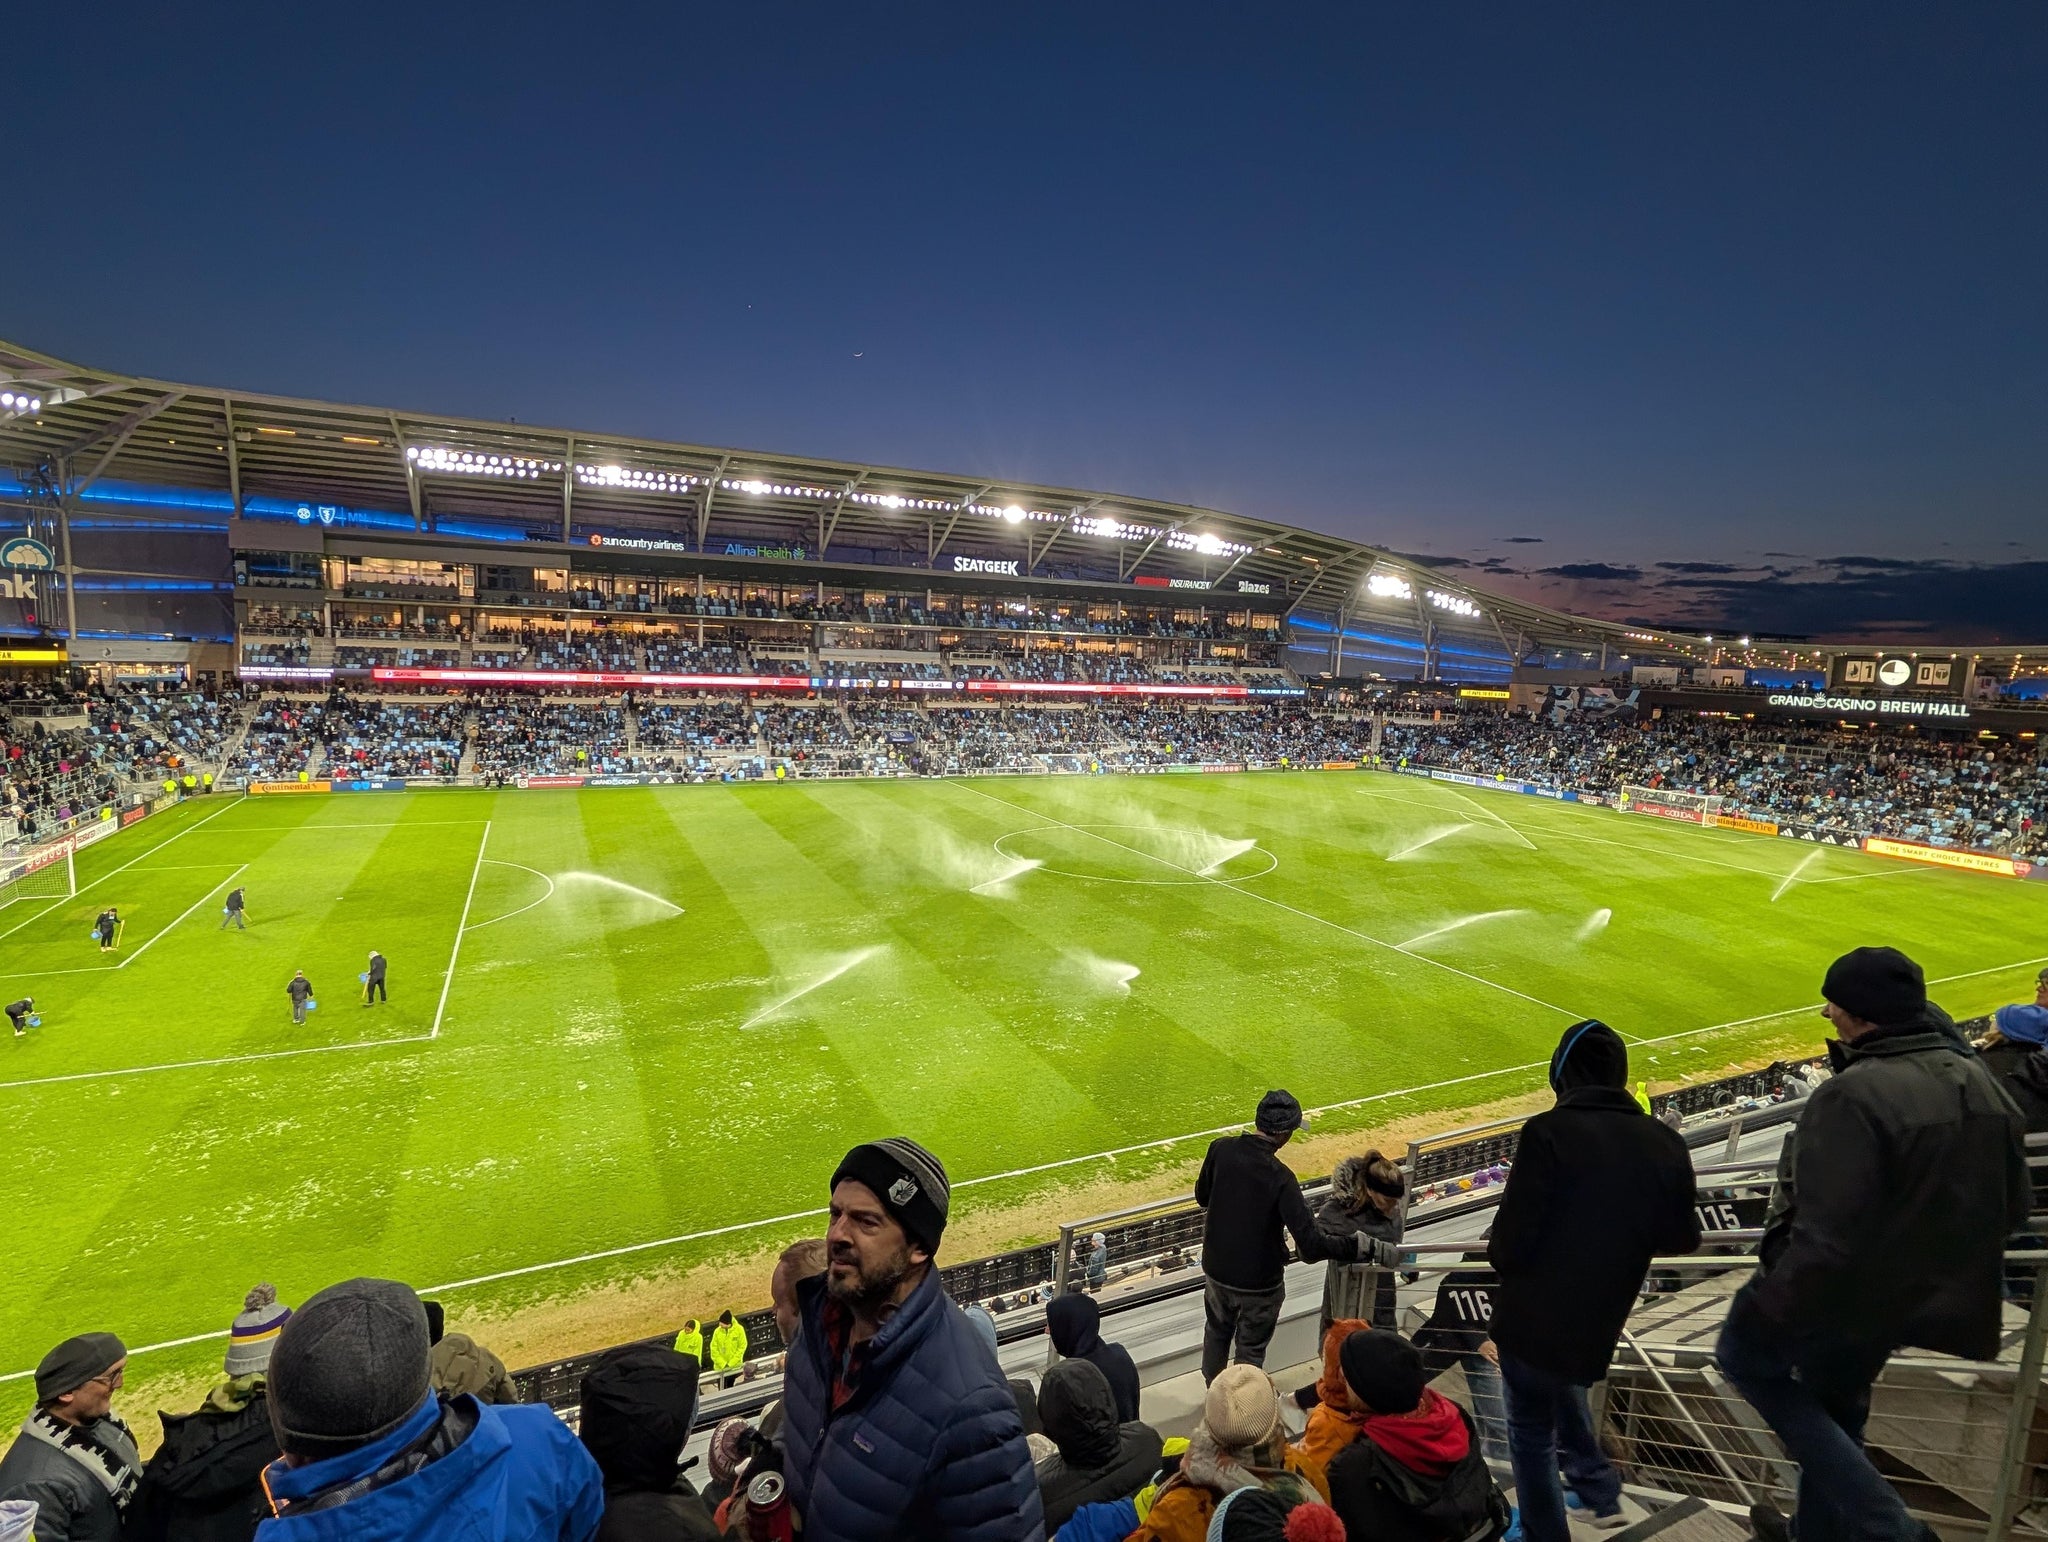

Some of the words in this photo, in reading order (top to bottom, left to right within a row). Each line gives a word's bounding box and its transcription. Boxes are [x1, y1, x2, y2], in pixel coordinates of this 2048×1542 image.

[602, 537, 619, 546] sun
[619, 538, 653, 551] country
[653, 540, 685, 551] airlines
[725, 543, 756, 557] Allina
[756, 545, 792, 559] Health
[953, 556, 1019, 577] SEATGEEK
[1169, 578, 1206, 590] INSURANCE
[1865, 665, 1873, 679] 1
[1921, 667, 1930, 680] 0
[1769, 694, 1813, 707] GRAND
[1826, 697, 1876, 711] CASINO
[1880, 700, 1924, 714] BREW
[1927, 703, 1971, 717] HALL
[1405, 767, 1429, 777] HYUNDAI
[262, 783, 311, 793] Continental
[1536, 788, 1556, 797] Allianz
[1641, 805, 1660, 814] Audi
[1902, 848, 1928, 857] SMART
[1930, 853, 1961, 863] CHOICE
[1976, 859, 2000, 869] TIRES
[1695, 1204, 1741, 1231] 115
[1448, 1290, 1493, 1321] 116
